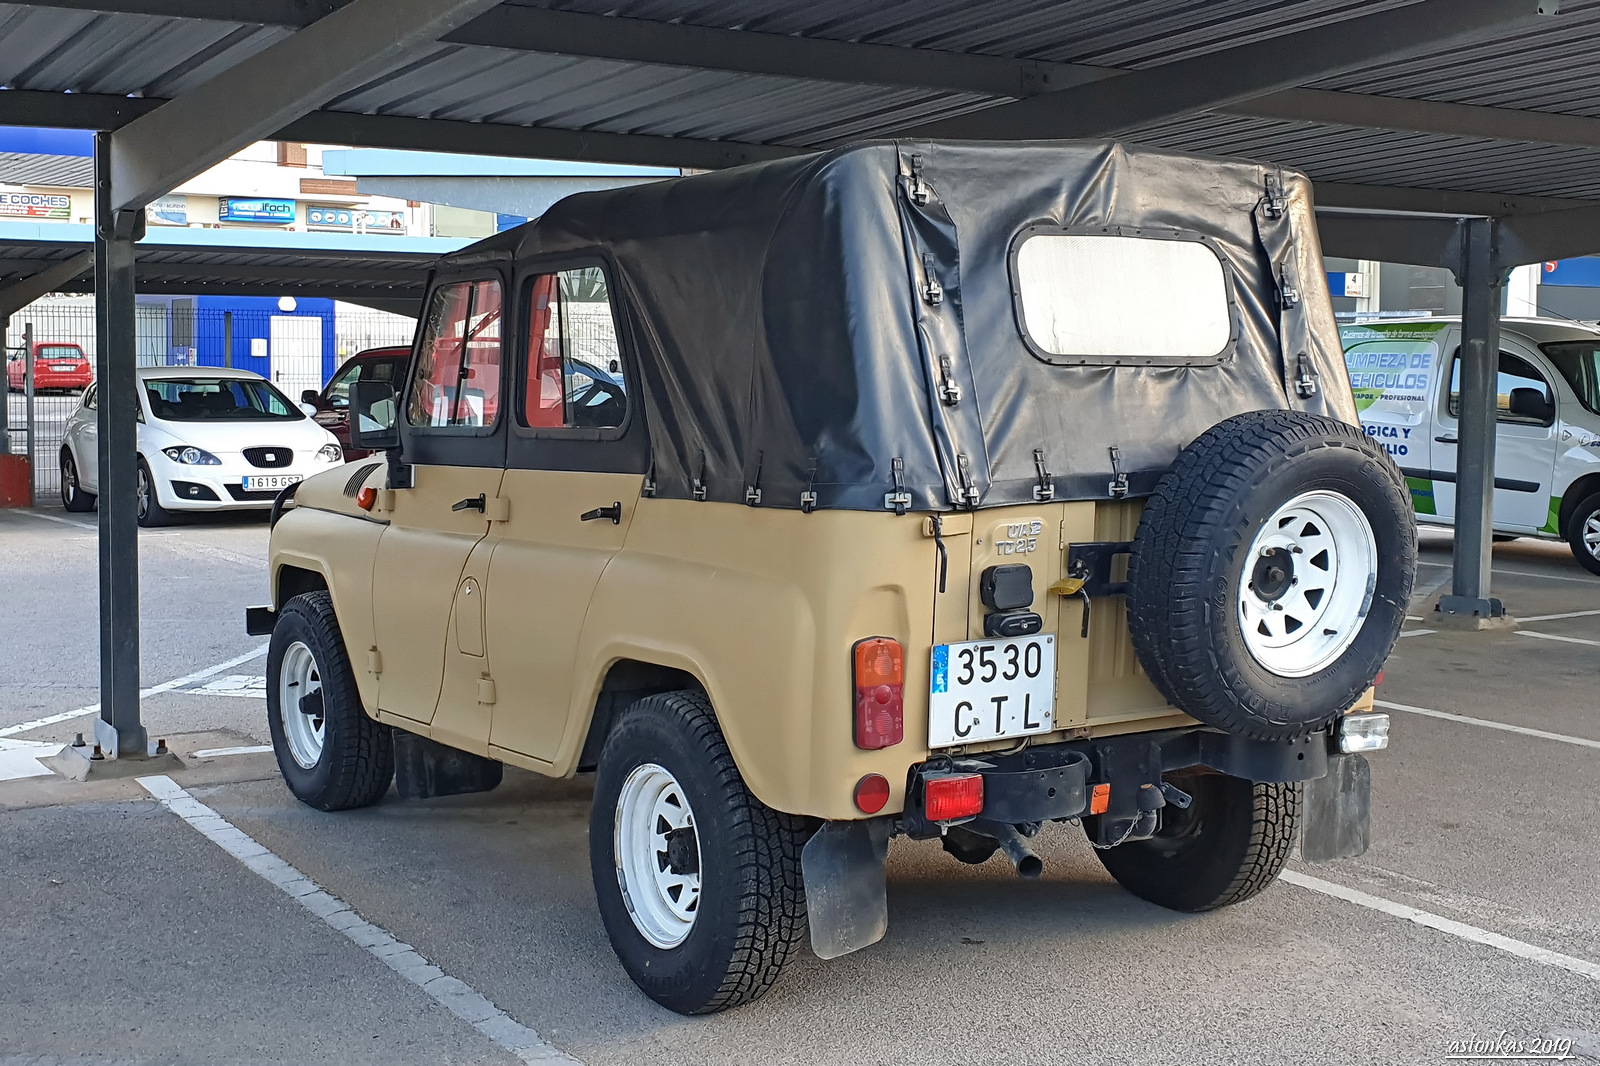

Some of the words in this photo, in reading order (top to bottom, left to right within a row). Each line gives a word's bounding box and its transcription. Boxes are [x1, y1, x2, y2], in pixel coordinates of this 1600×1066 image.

[11, 194, 68, 206] COCHES
[262, 202, 291, 212] ifach
[1410, 353, 1432, 369] DE
[1380, 394, 1425, 402] PROFESIONAL
[1402, 427, 1411, 439] Y
[251, 477, 277, 488] 1619
[956, 641, 1041, 686] 3530
